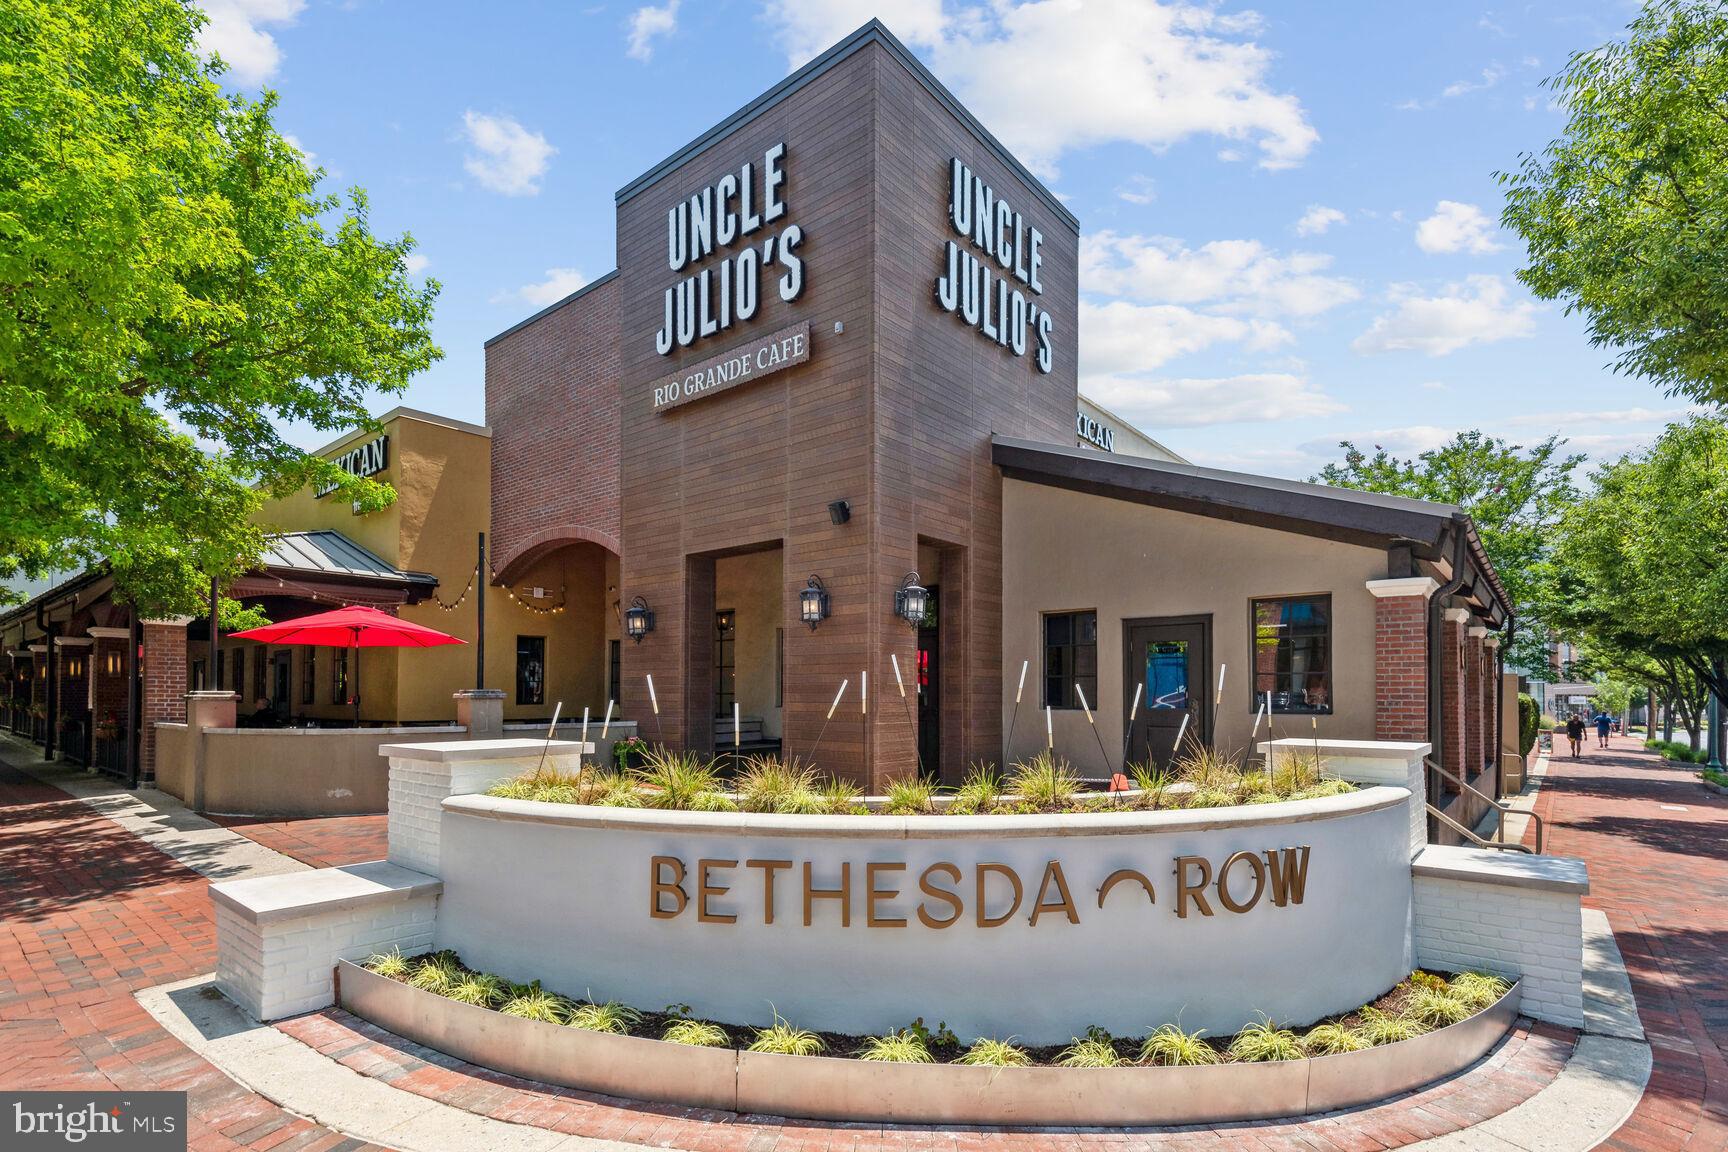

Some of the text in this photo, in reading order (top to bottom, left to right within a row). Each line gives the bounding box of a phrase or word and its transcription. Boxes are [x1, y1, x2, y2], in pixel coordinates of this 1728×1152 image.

[668, 142, 787, 273] UNCLE
[949, 157, 1043, 296] UNCLE
[656, 224, 805, 356] JULIO'S
[935, 240, 1053, 375] JULIO'S
[654, 333, 805, 408] RIO GRANDE CAFE
[650, 845, 1311, 929] BETHESDA ROW
